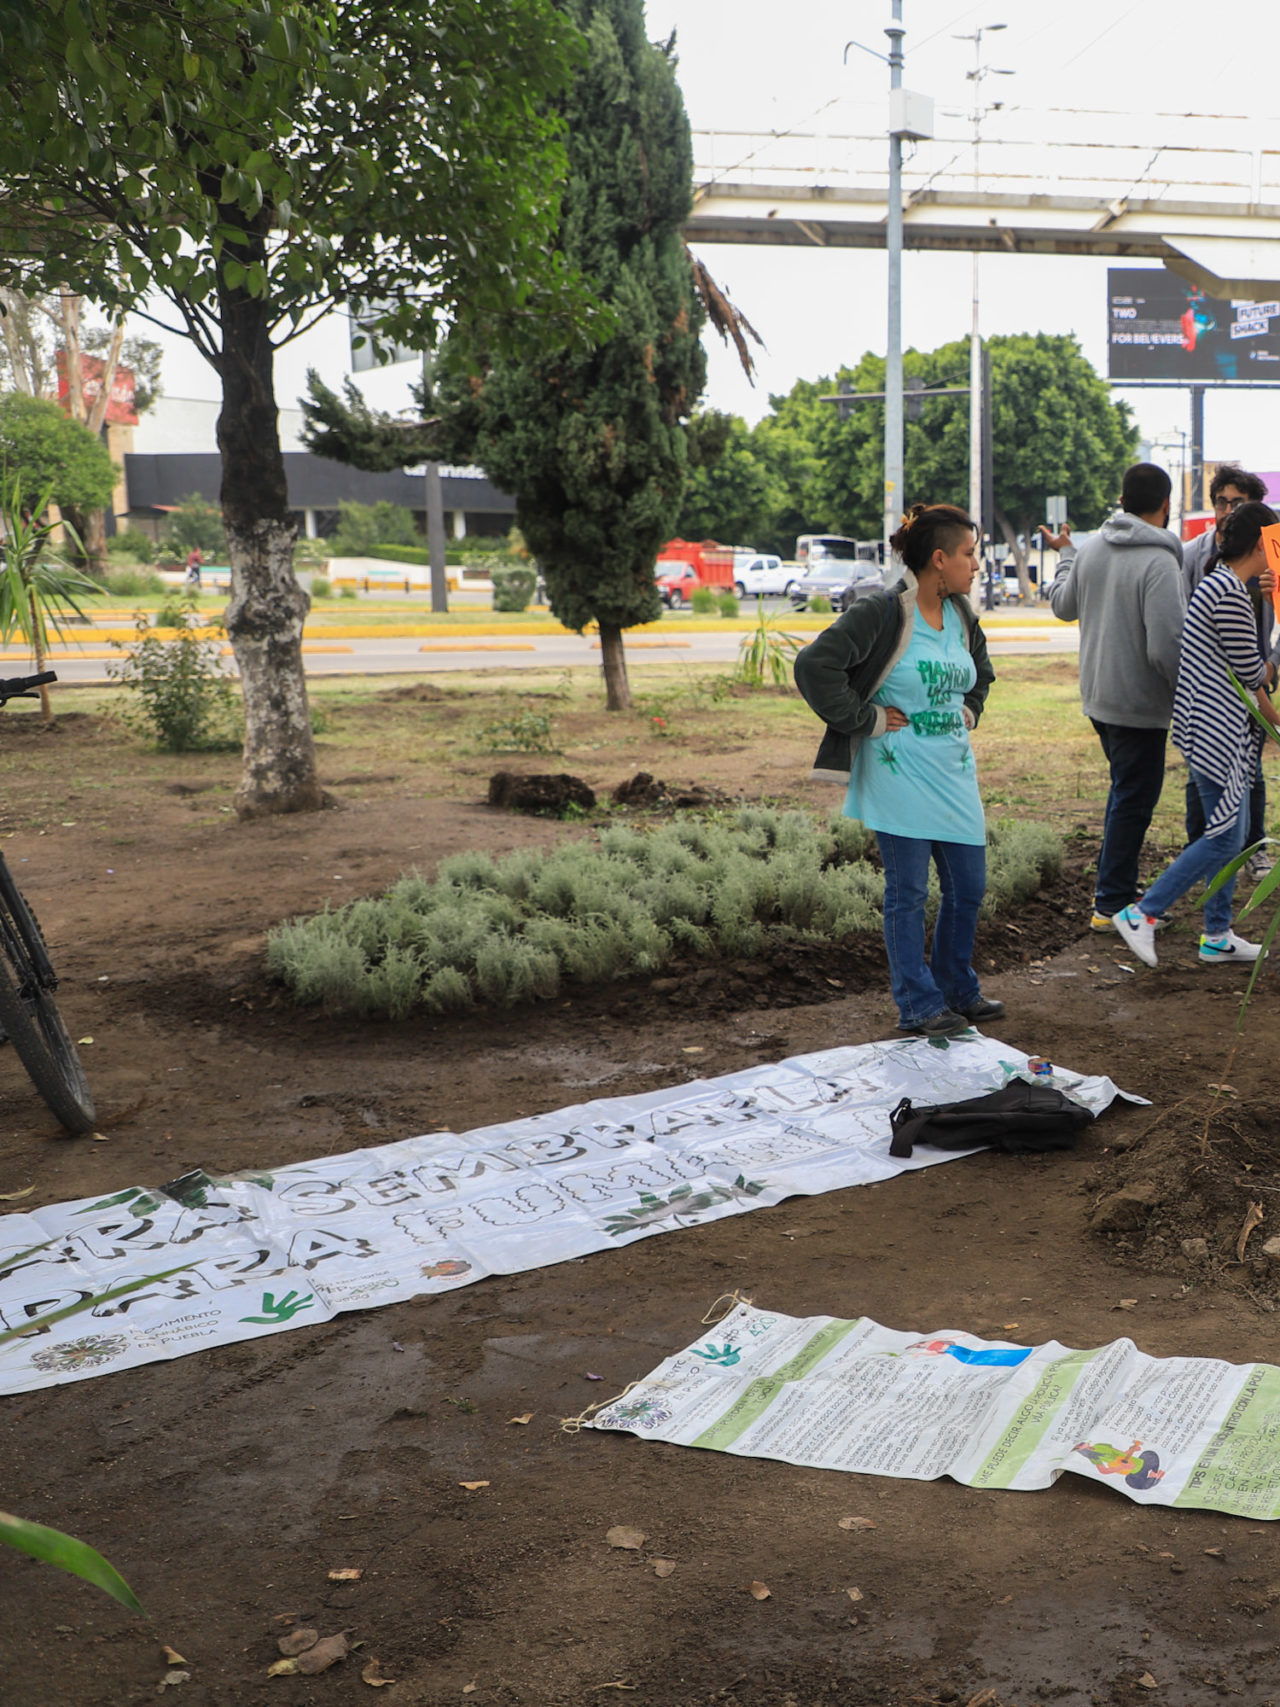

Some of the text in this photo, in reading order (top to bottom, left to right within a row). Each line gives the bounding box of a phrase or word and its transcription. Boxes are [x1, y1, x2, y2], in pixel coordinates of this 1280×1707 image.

[1112, 307, 1137, 319] TWO
[749, 1315, 778, 1338] 420
[161, 1329, 218, 1346] PUEBLA
[1241, 1387, 1257, 1397] LA
[1233, 1397, 1252, 1412] CON
[983, 1448, 1010, 1470] PUEDE
[999, 1426, 1023, 1448] DECIR
[1012, 1404, 1036, 1425] ALGO
[1205, 1446, 1220, 1457] UN
[1187, 1470, 1209, 1489] TIPS
[1220, 1466, 1244, 1490] CAER
